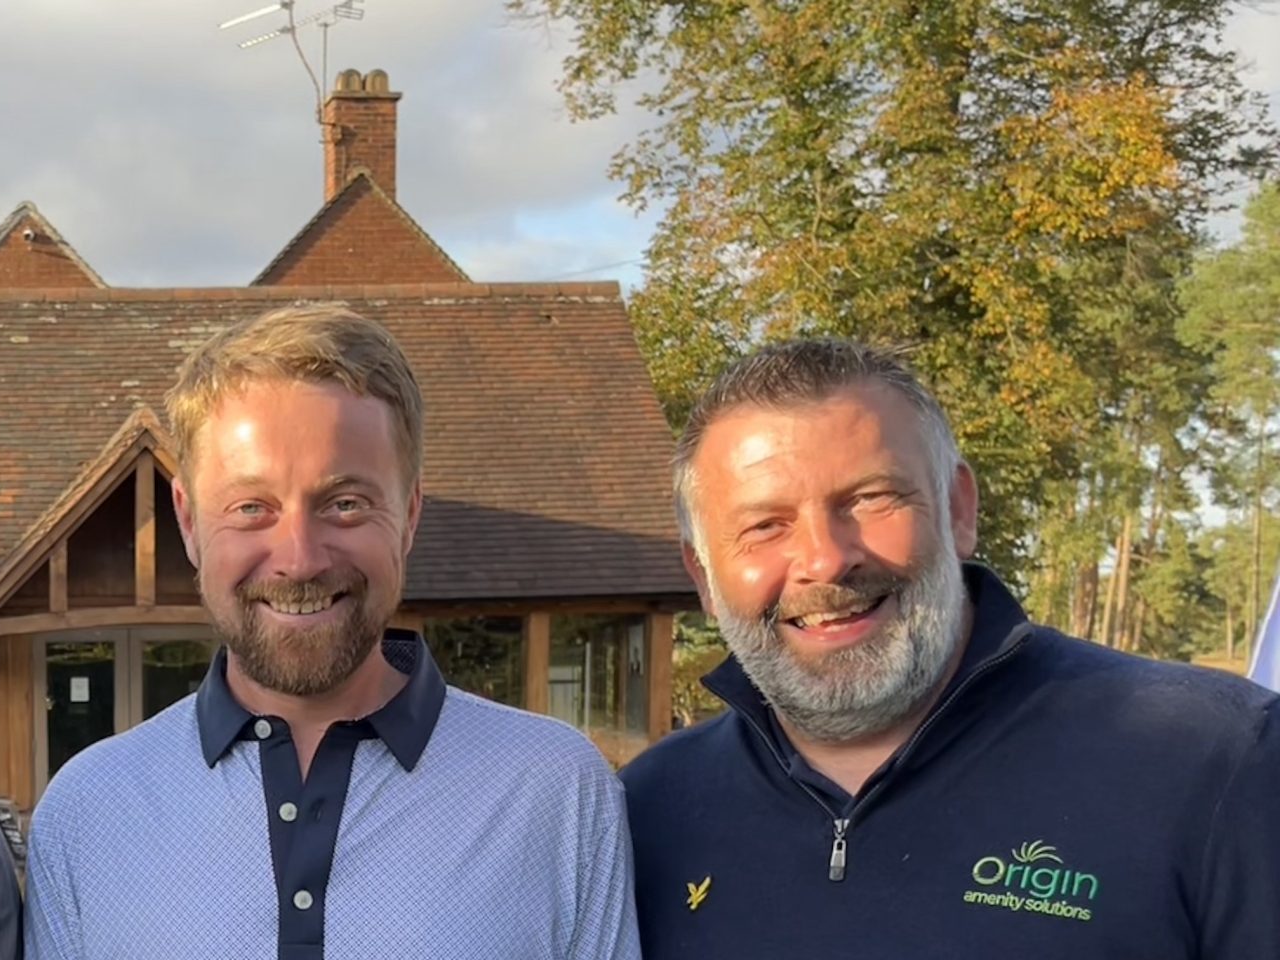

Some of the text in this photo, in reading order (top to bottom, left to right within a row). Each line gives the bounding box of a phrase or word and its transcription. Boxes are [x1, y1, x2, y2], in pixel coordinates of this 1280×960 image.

[972, 856, 1099, 899] Origin
[963, 890, 1092, 920] amenity solutions
